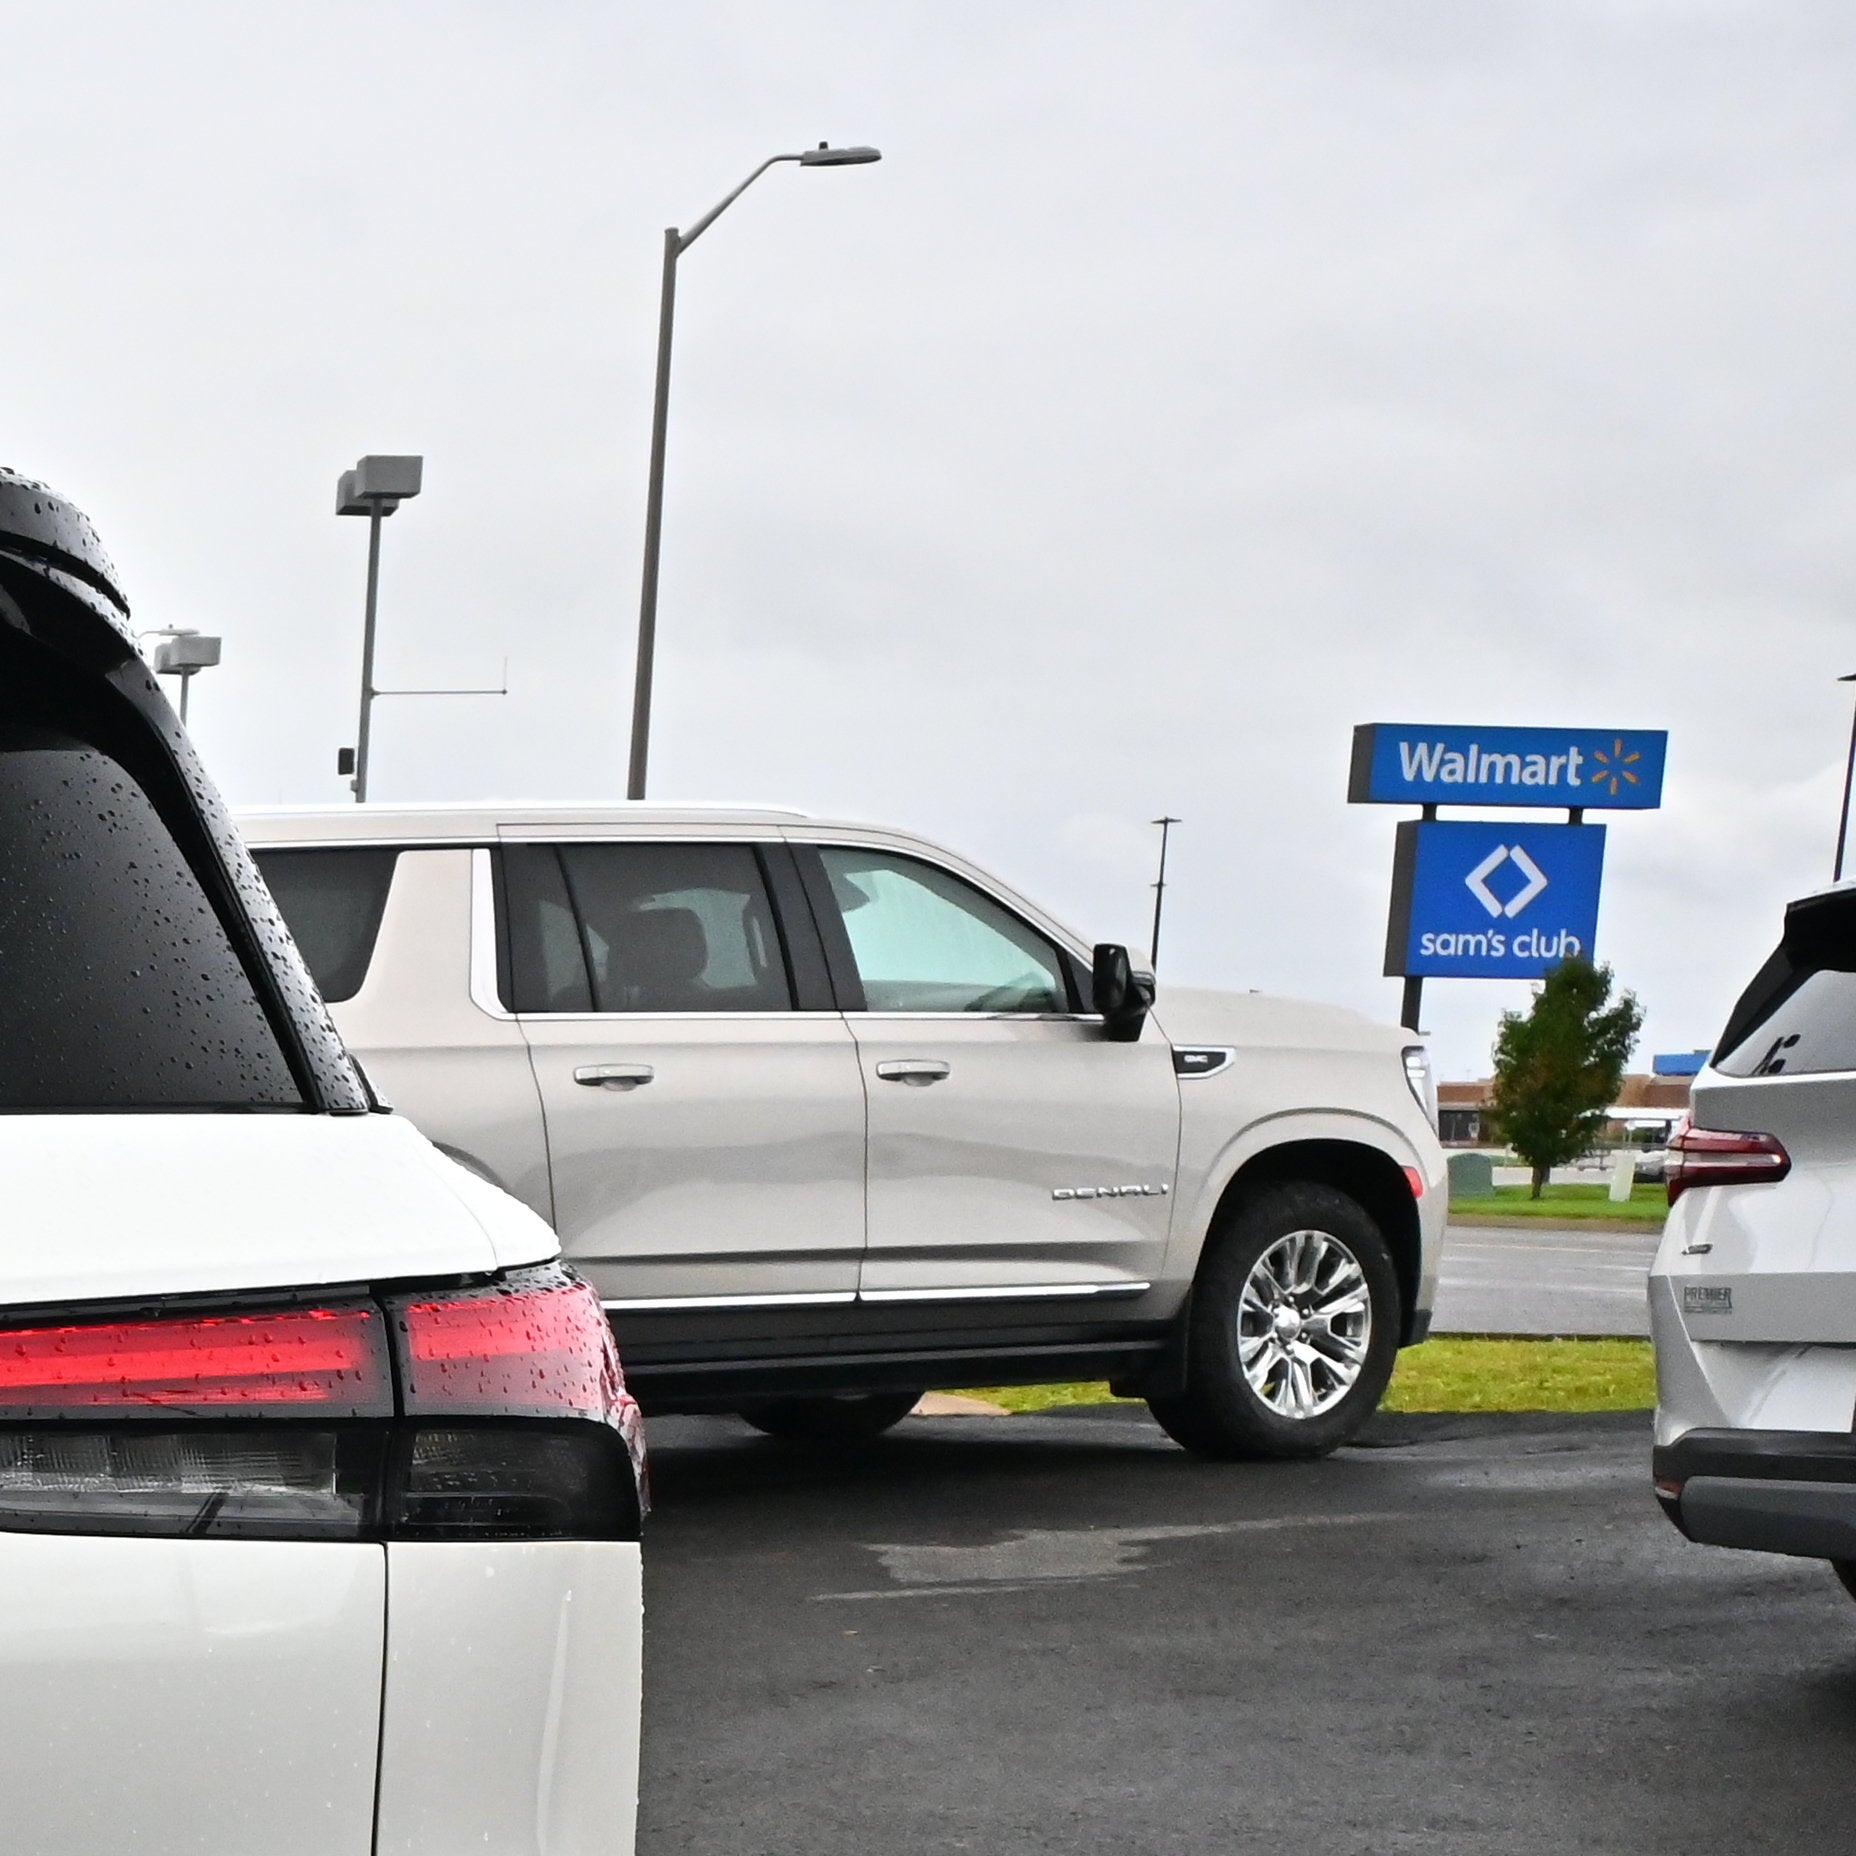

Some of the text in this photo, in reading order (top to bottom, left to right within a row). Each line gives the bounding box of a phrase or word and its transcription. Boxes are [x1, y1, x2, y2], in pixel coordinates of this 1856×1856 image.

[1399, 741, 1584, 786] Walmart
[1420, 928, 1581, 958] sam's club
[1052, 1184, 1169, 1201] DENALI
